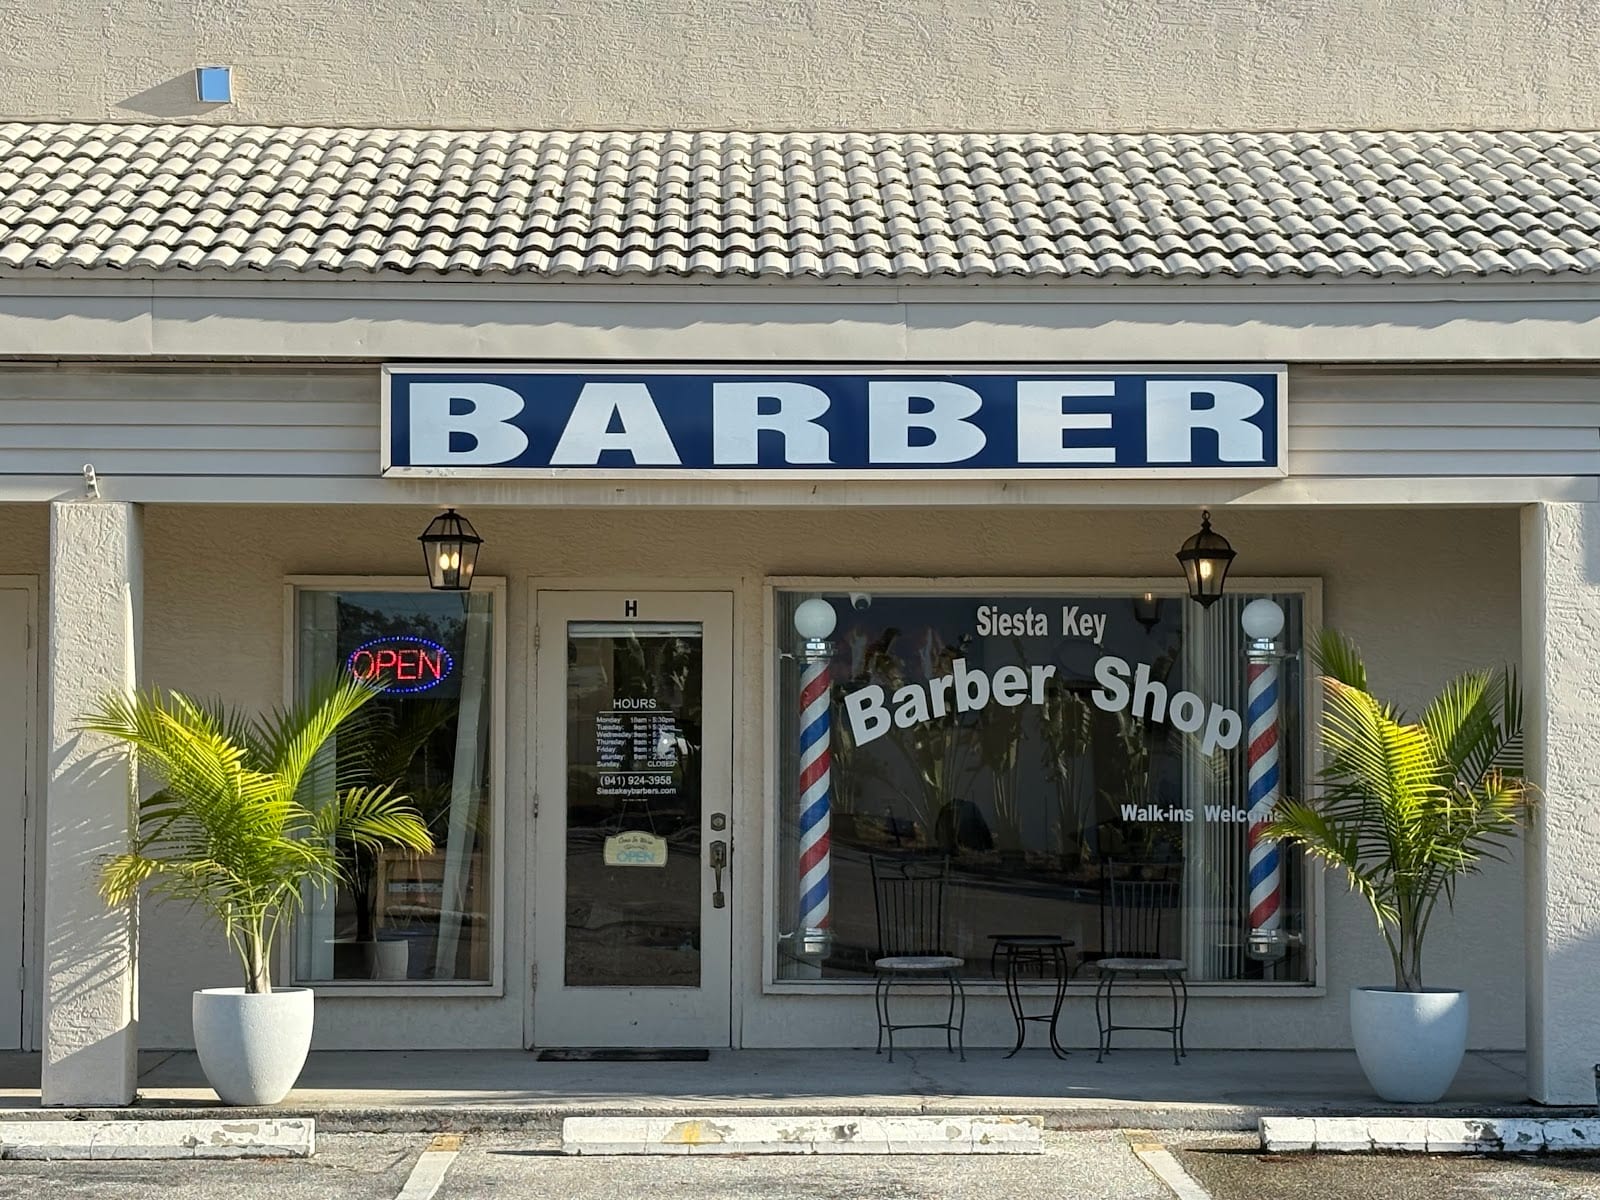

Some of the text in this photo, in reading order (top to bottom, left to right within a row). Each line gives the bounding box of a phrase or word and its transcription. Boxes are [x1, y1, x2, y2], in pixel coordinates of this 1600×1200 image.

[408, 380, 1266, 466] BARBER
[625, 599, 638, 617] H
[976, 606, 1107, 644] Siesta Key
[353, 649, 442, 681] OPEN
[613, 698, 657, 709] HOURS
[844, 656, 1243, 758] Barber Shop
[600, 776, 672, 787] (941) 924-3958
[1121, 804, 1195, 822] Walk-ins
[616, 851, 656, 863] OPEN
